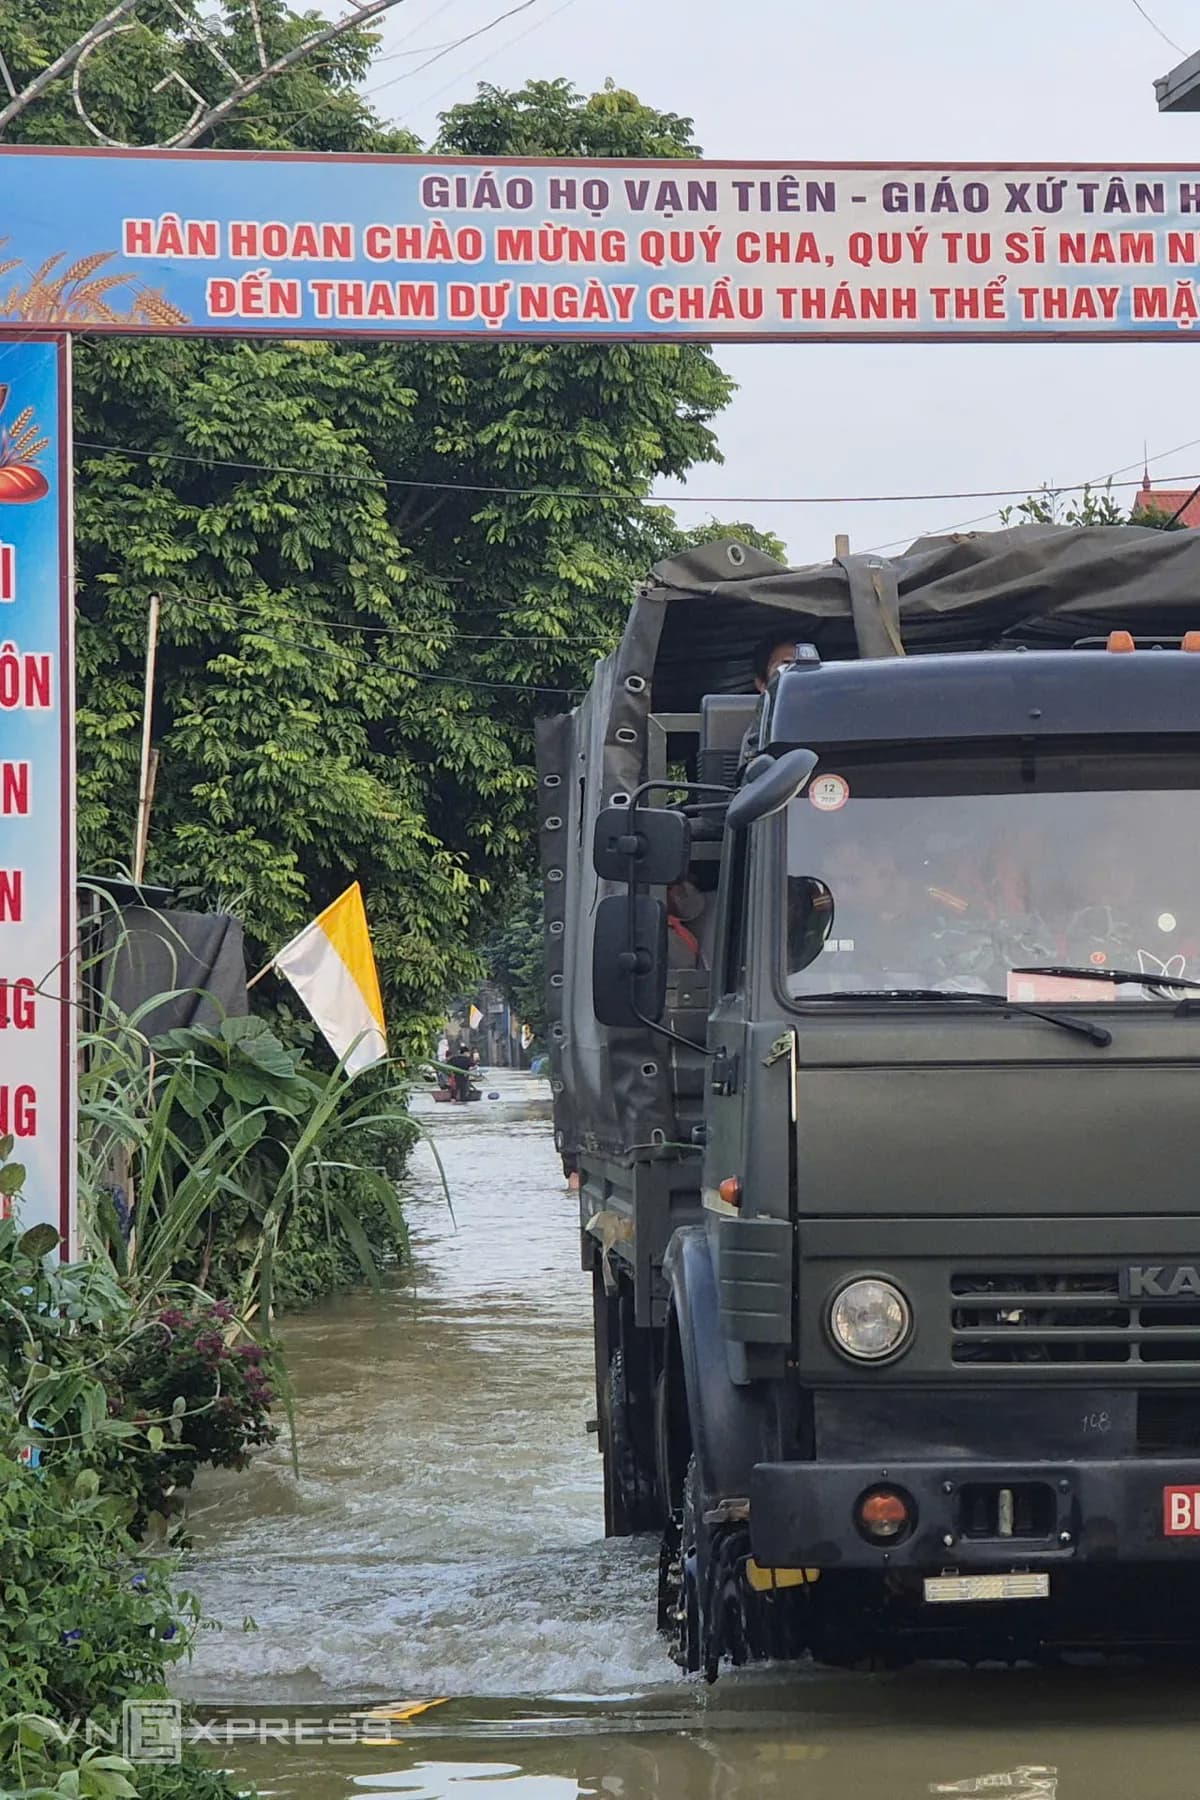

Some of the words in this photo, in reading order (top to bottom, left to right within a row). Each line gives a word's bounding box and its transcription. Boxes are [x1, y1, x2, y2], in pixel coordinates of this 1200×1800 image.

[422, 171, 533, 211] GIÁO
[550, 178, 609, 218] HỌ
[625, 180, 717, 219] VẠN
[735, 174, 836, 213] TIÊN
[851, 196, 866, 204] -
[882, 175, 988, 213] GIÁO
[1004, 178, 1067, 213] XỨ
[1076, 175, 1165, 213] TÂN
[126, 216, 216, 257] HÂN
[231, 224, 351, 258] HOAN
[366, 221, 483, 261] CHÀO
[497, 222, 626, 263] MỪNG
[640, 225, 721, 266] QUÝ
[736, 231, 835, 265] CHA,
[849, 226, 929, 267] QUÝ
[942, 232, 991, 264] TU
[1004, 226, 1046, 264] SĨ
[1059, 232, 1154, 264] NAM
[209, 271, 298, 314] ĐẾN
[311, 282, 435, 316] THAM
[450, 283, 511, 325] DỰ
[520, 279, 637, 319] NGÀY
[649, 276, 764, 320] CHẦU
[776, 281, 918, 320] THÁNH
[930, 275, 1008, 319] THỂ
[1018, 287, 1121, 319] THAY
